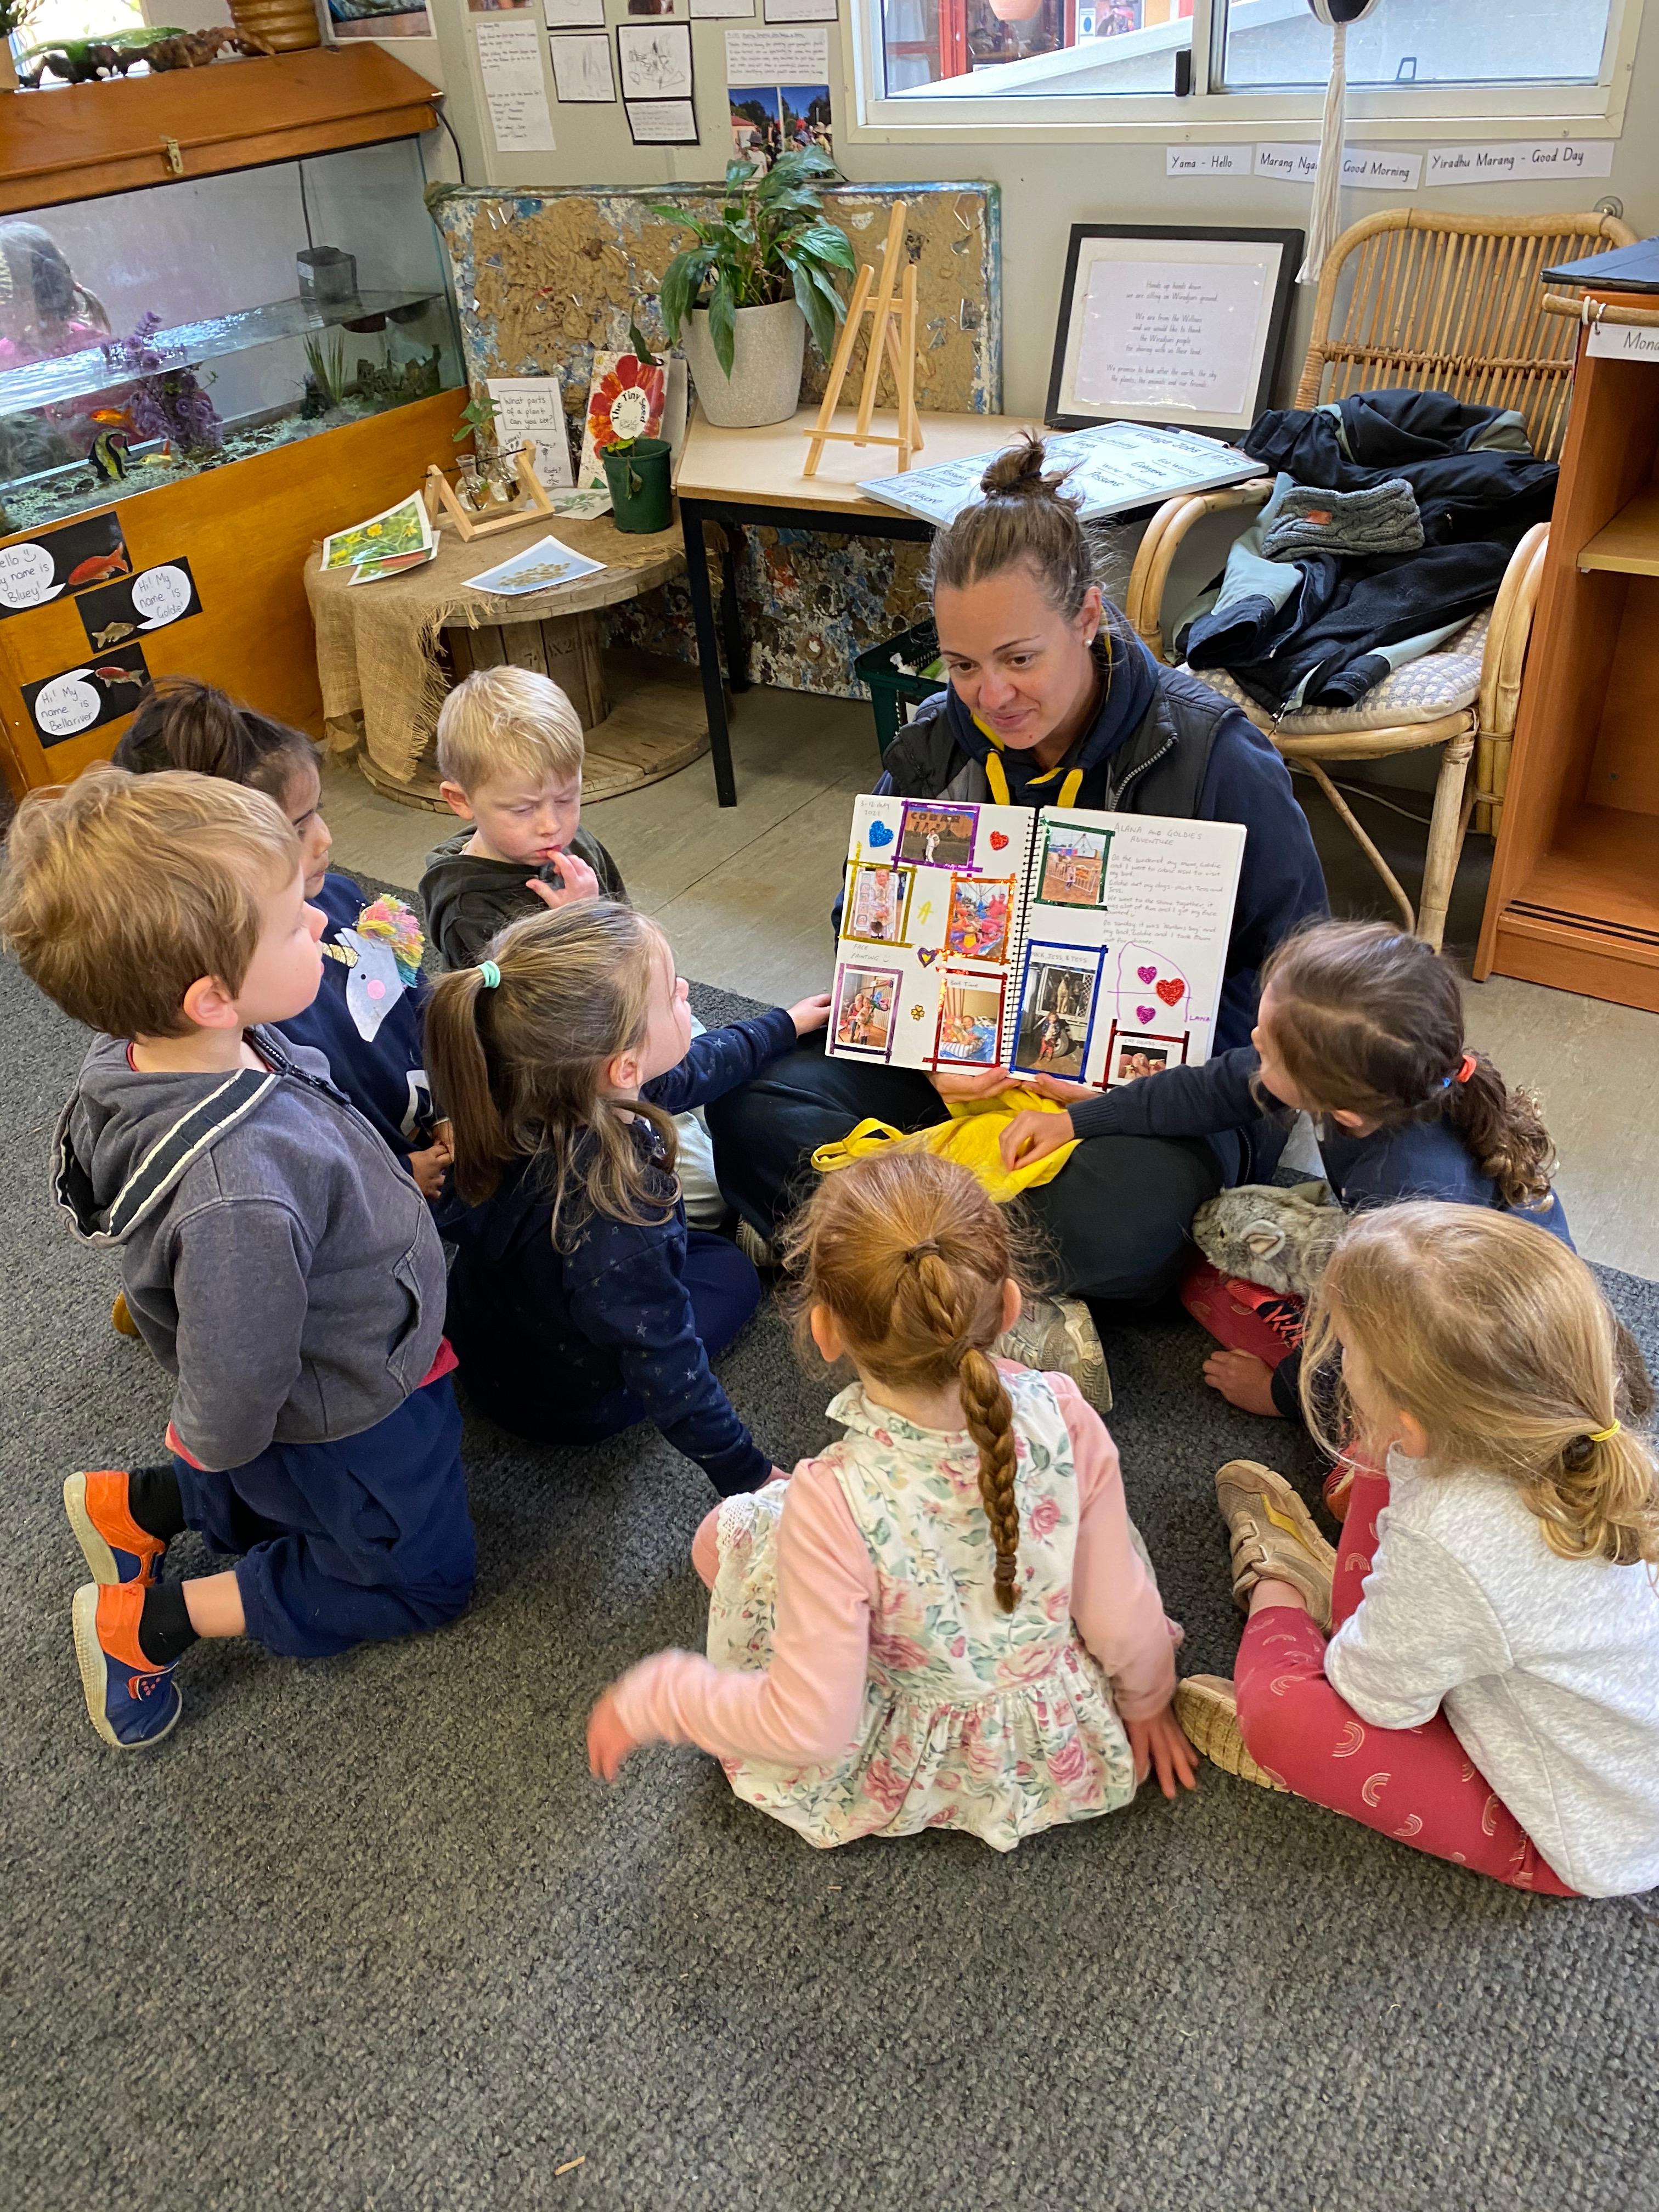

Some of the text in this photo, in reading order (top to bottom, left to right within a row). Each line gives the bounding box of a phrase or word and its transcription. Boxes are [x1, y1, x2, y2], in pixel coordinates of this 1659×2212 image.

[1172, 155, 1232, 168] Yama Hello
[1261, 153, 1293, 173] Marang
[1343, 160, 1365, 174] Good
[1370, 162, 1410, 182] Morning
[1431, 148, 1584, 171] Yiradhu Marang Good Day
[1135, 312, 1144, 320] We
[504, 395, 546, 407] What parts
[612, 391, 647, 423] The Tiny Seed
[506, 408, 515, 417] of
[525, 407, 545, 418] plant
[524, 419, 537, 430] you
[1135, 432, 1173, 444] Village
[1172, 442, 1201, 453] Jobs
[0, 553, 19, 568] ello
[10, 563, 49, 581] name is
[138, 573, 171, 592] Hi! My
[140, 588, 180, 608] name is
[41, 686, 78, 704] Hi! My
[41, 699, 89, 718] name is
[49, 712, 93, 731] Bellariver
[911, 812, 960, 823] COBAR
[1114, 822, 1142, 833] ALANA
[1130, 836, 1174, 845] ADVENTURE
